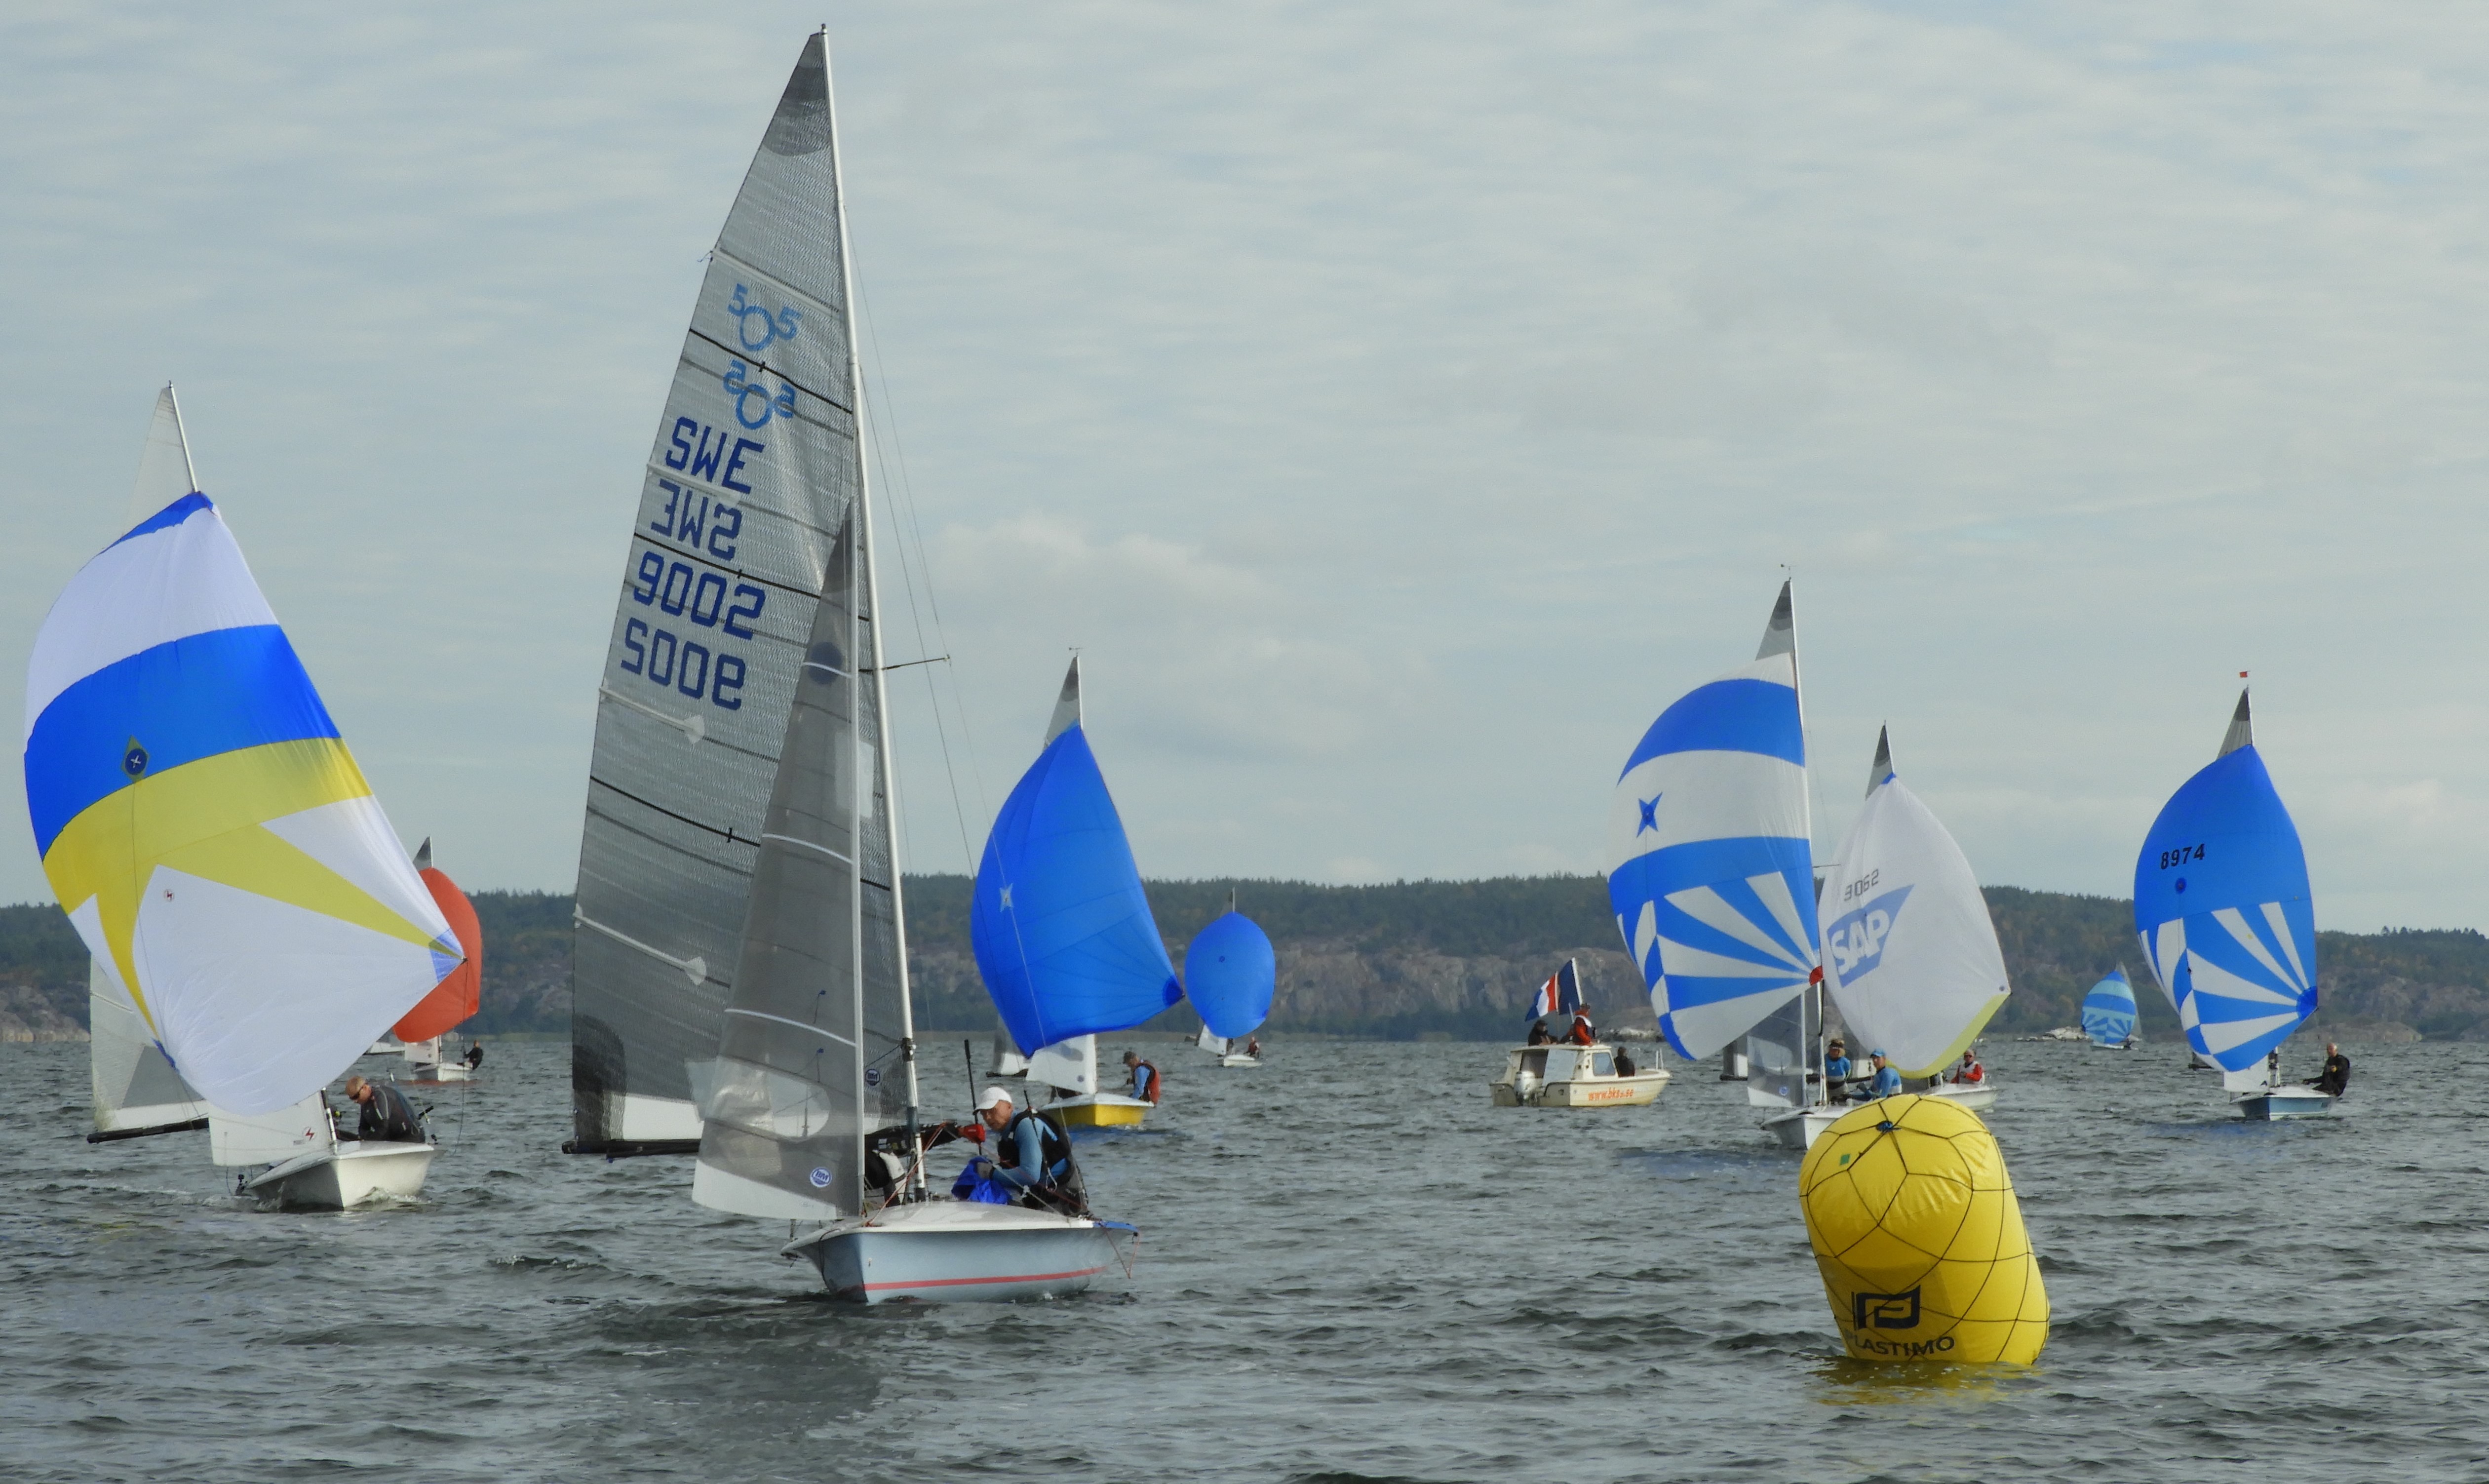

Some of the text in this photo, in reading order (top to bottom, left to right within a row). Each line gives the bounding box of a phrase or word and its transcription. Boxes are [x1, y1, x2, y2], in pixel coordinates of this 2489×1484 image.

[665, 416, 765, 494] SWE
[633, 550, 766, 640] 9002
[2161, 843, 2205, 869] 8974
[1831, 909, 1890, 976] SAP
